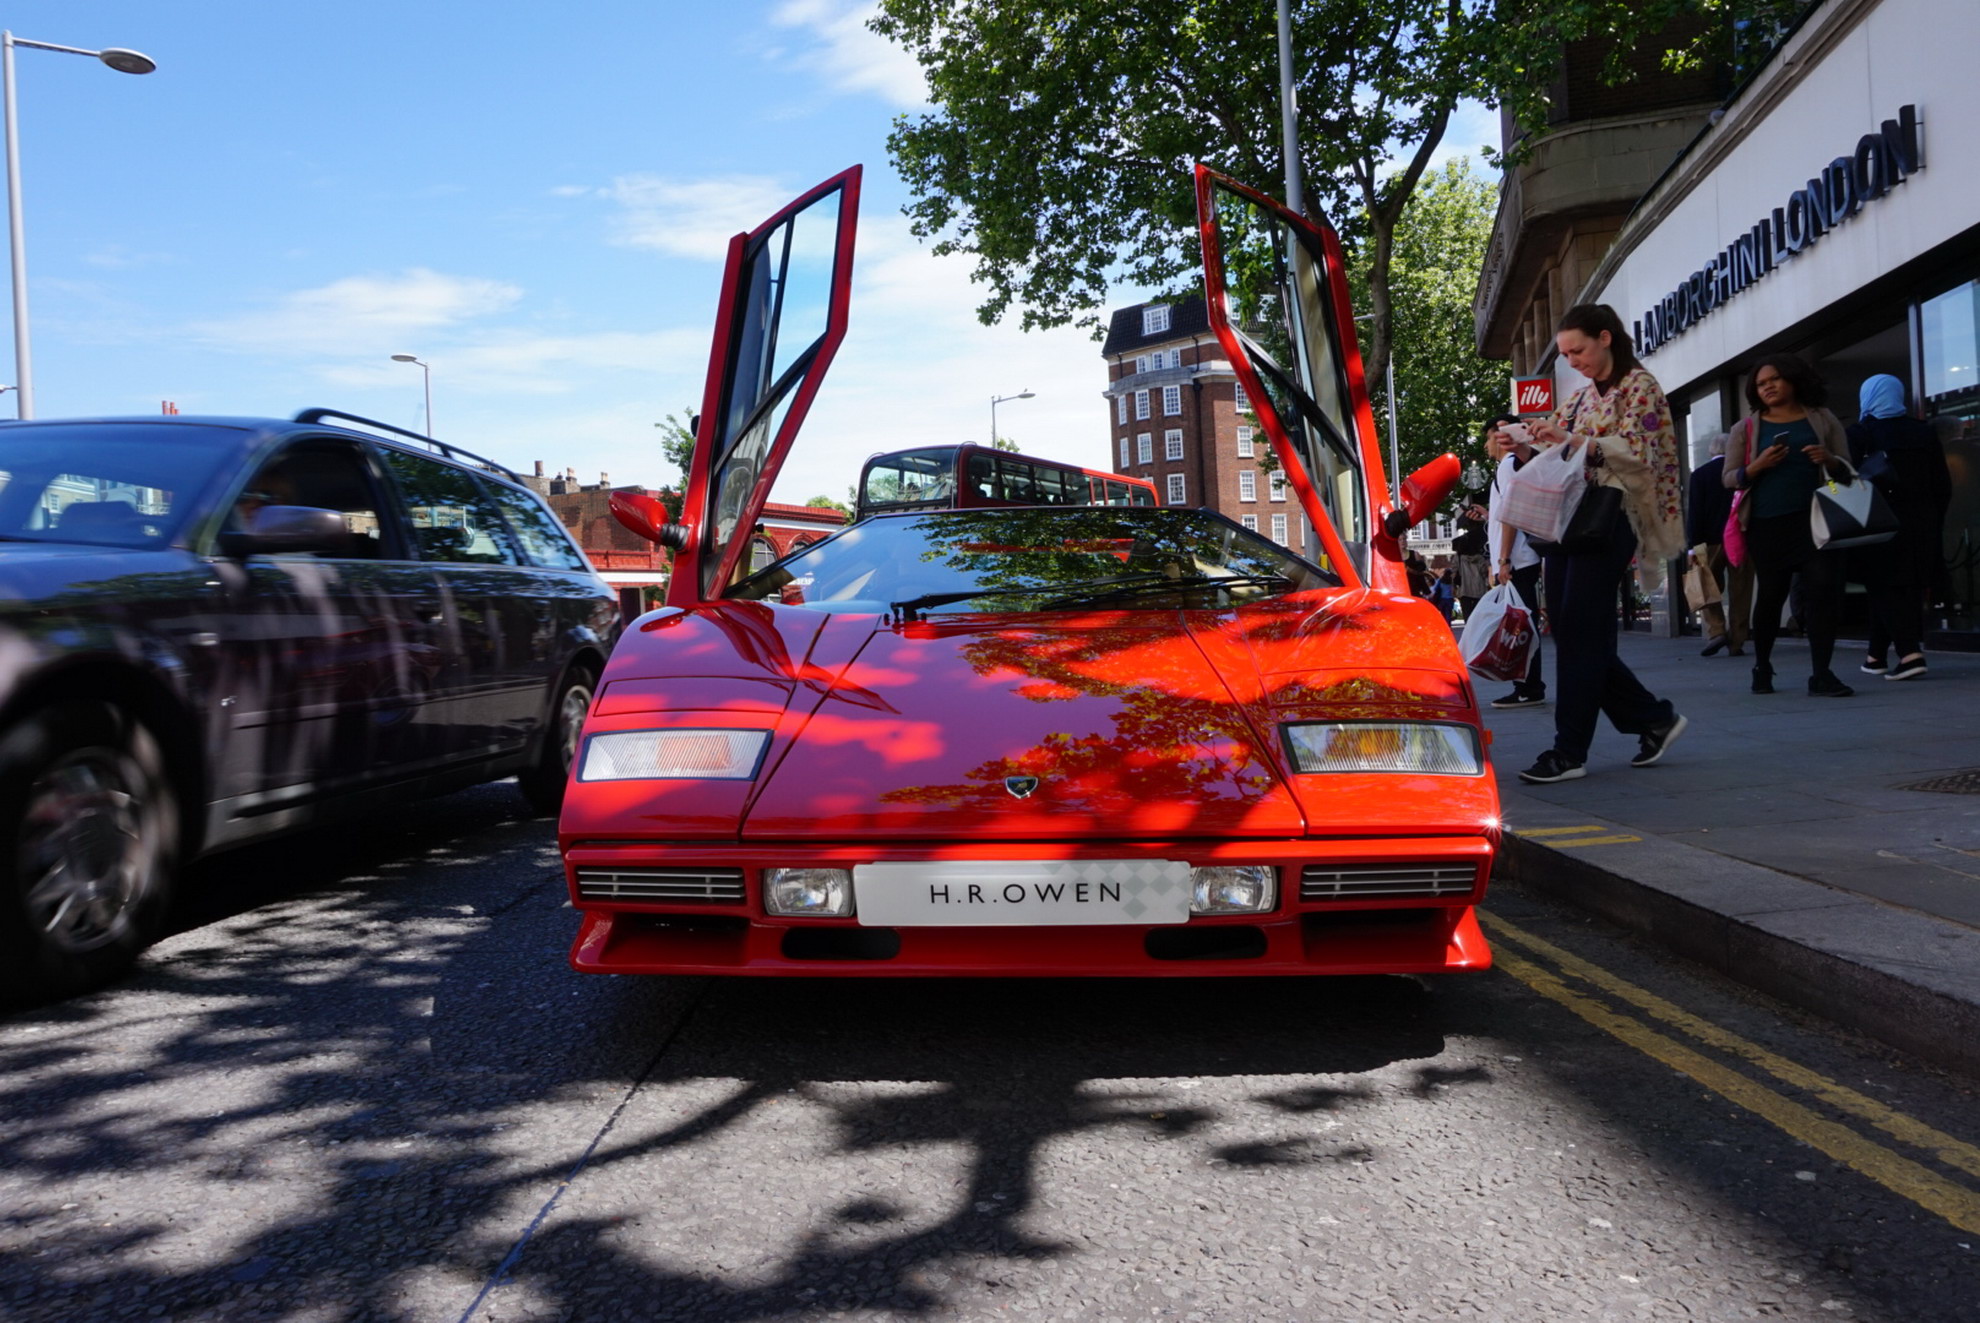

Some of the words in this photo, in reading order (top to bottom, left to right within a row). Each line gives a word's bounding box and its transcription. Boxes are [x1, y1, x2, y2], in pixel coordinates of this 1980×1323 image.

[1633, 217, 1775, 360] LAMBORGHINI
[1772, 103, 1917, 265] LONDON
[1520, 385, 1550, 409] illy
